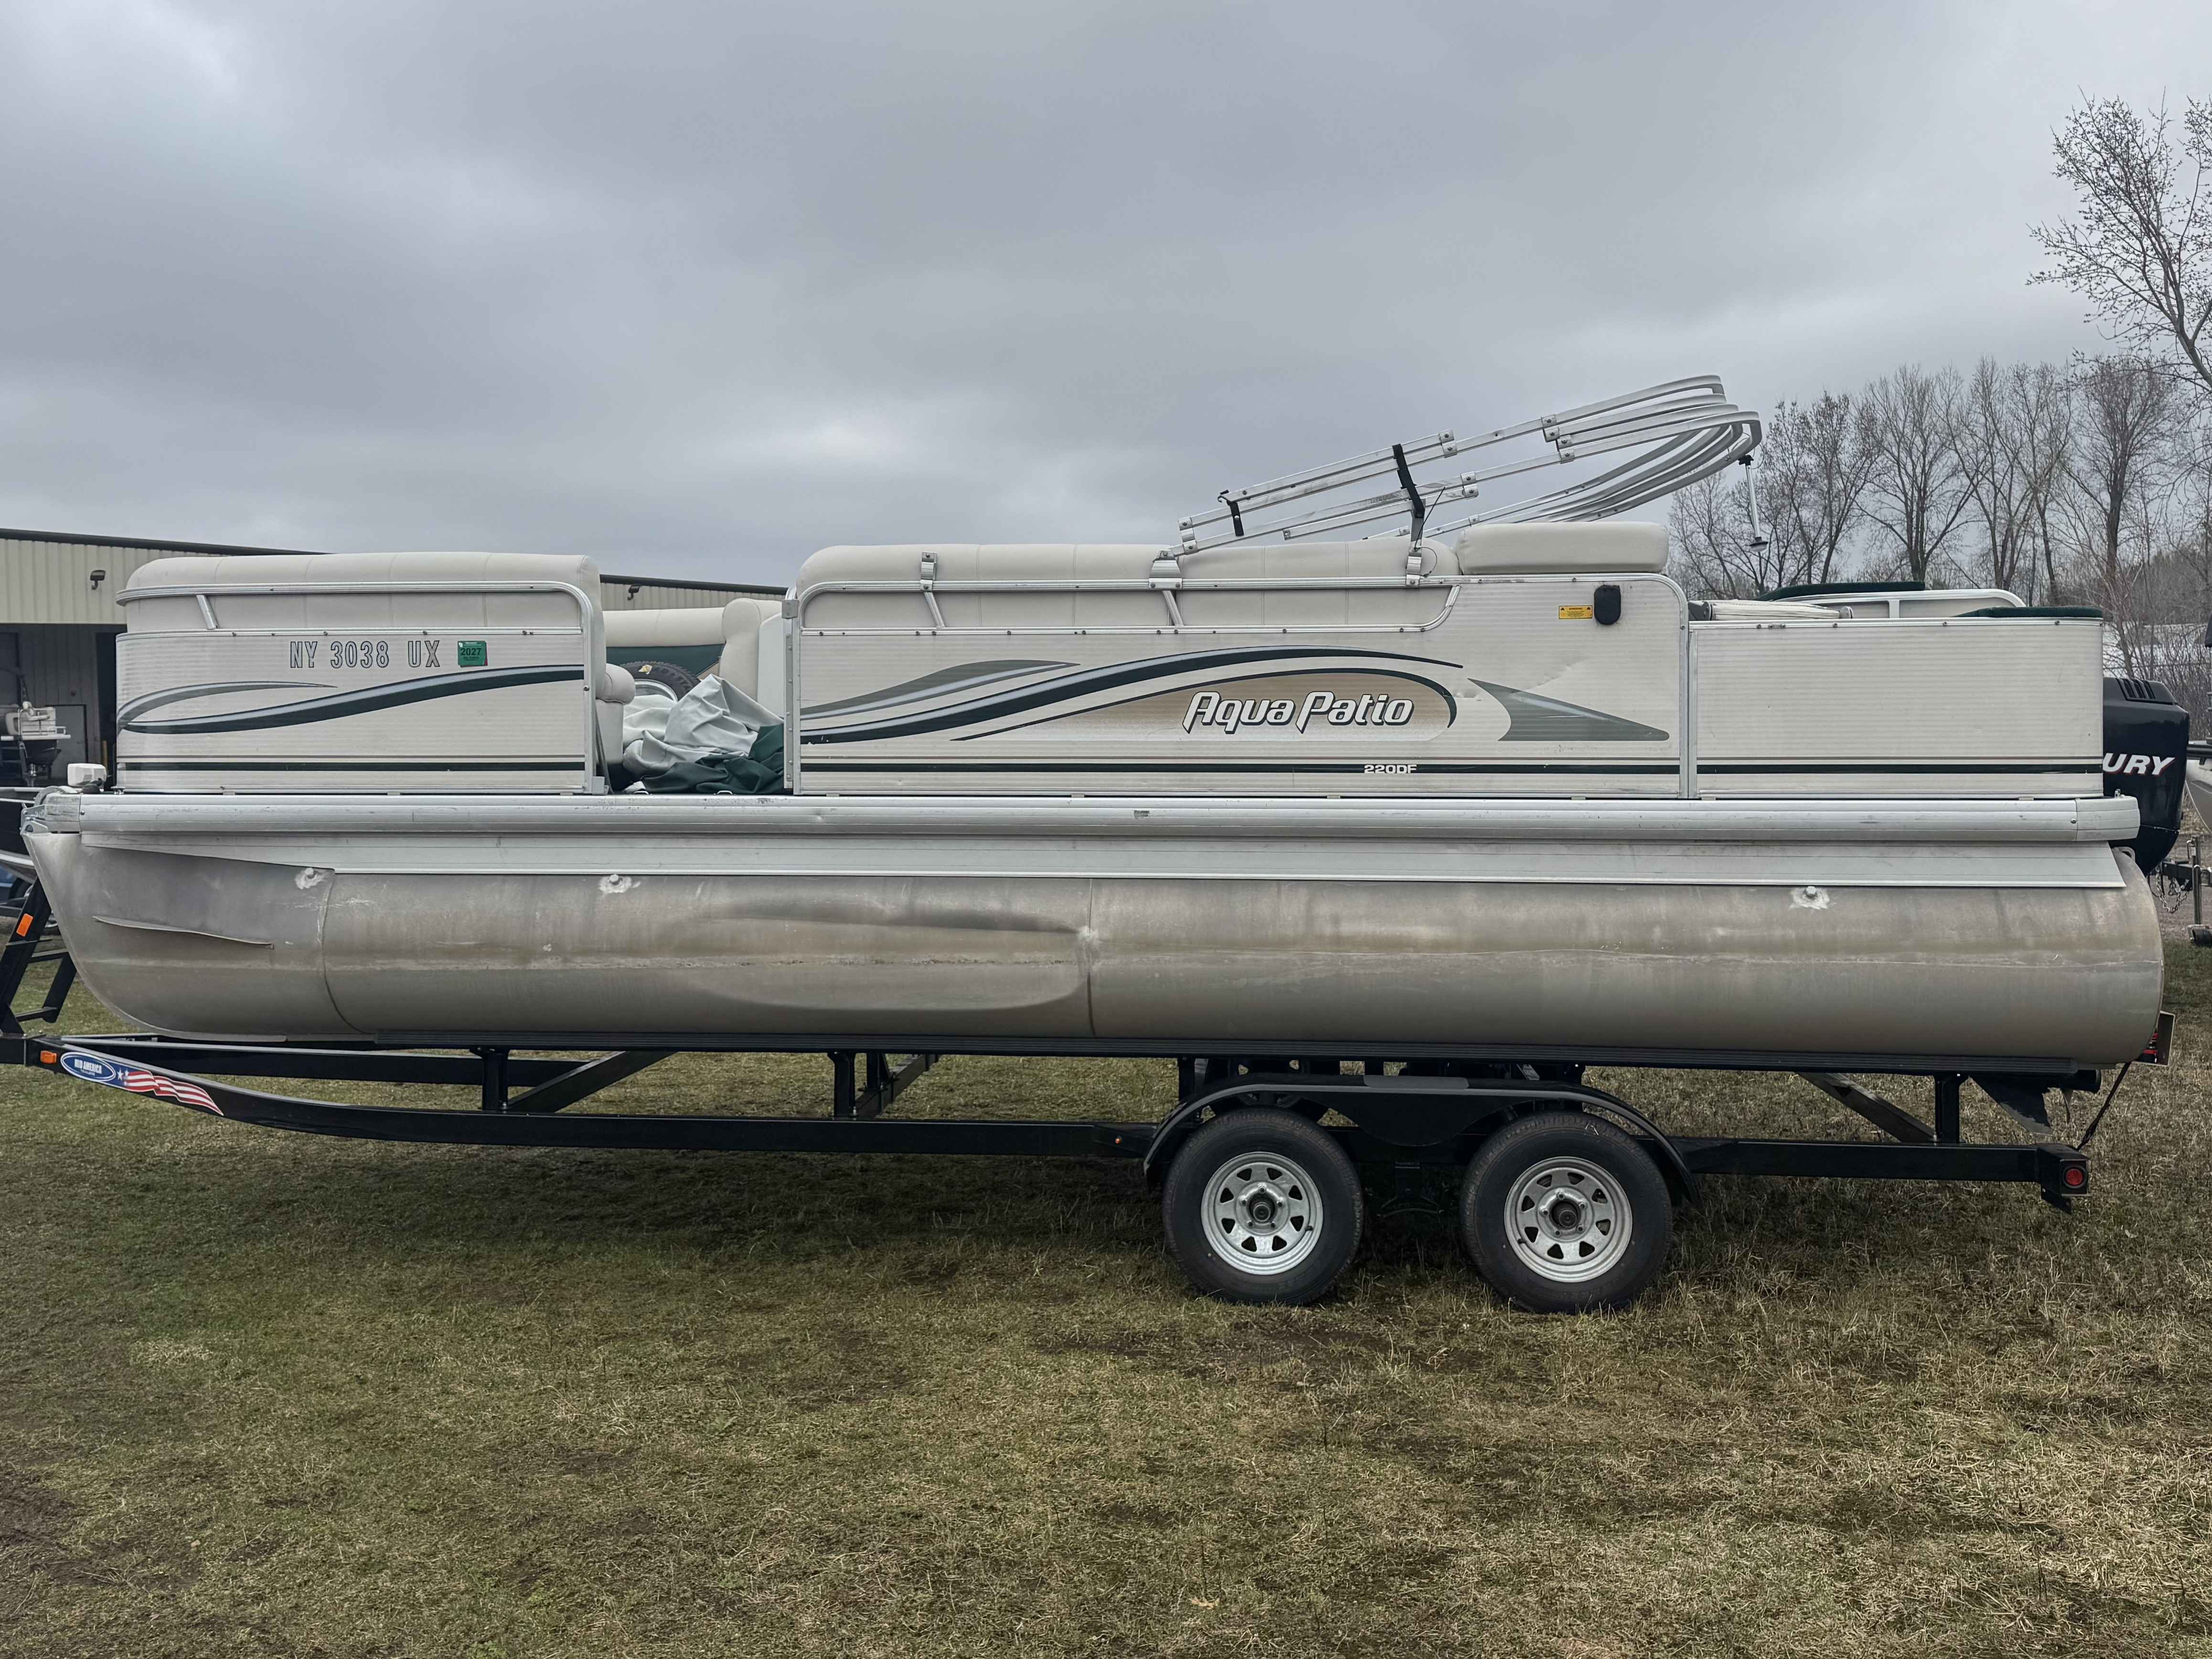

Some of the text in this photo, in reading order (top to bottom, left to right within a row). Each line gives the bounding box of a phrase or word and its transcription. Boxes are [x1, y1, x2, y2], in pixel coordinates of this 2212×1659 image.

[290, 640, 440, 669] NY 3038 UX
[1182, 691, 1414, 734] Aqua Patio
[2103, 752, 2176, 776] URY
[83, 1061, 102, 1074] AMERICA
